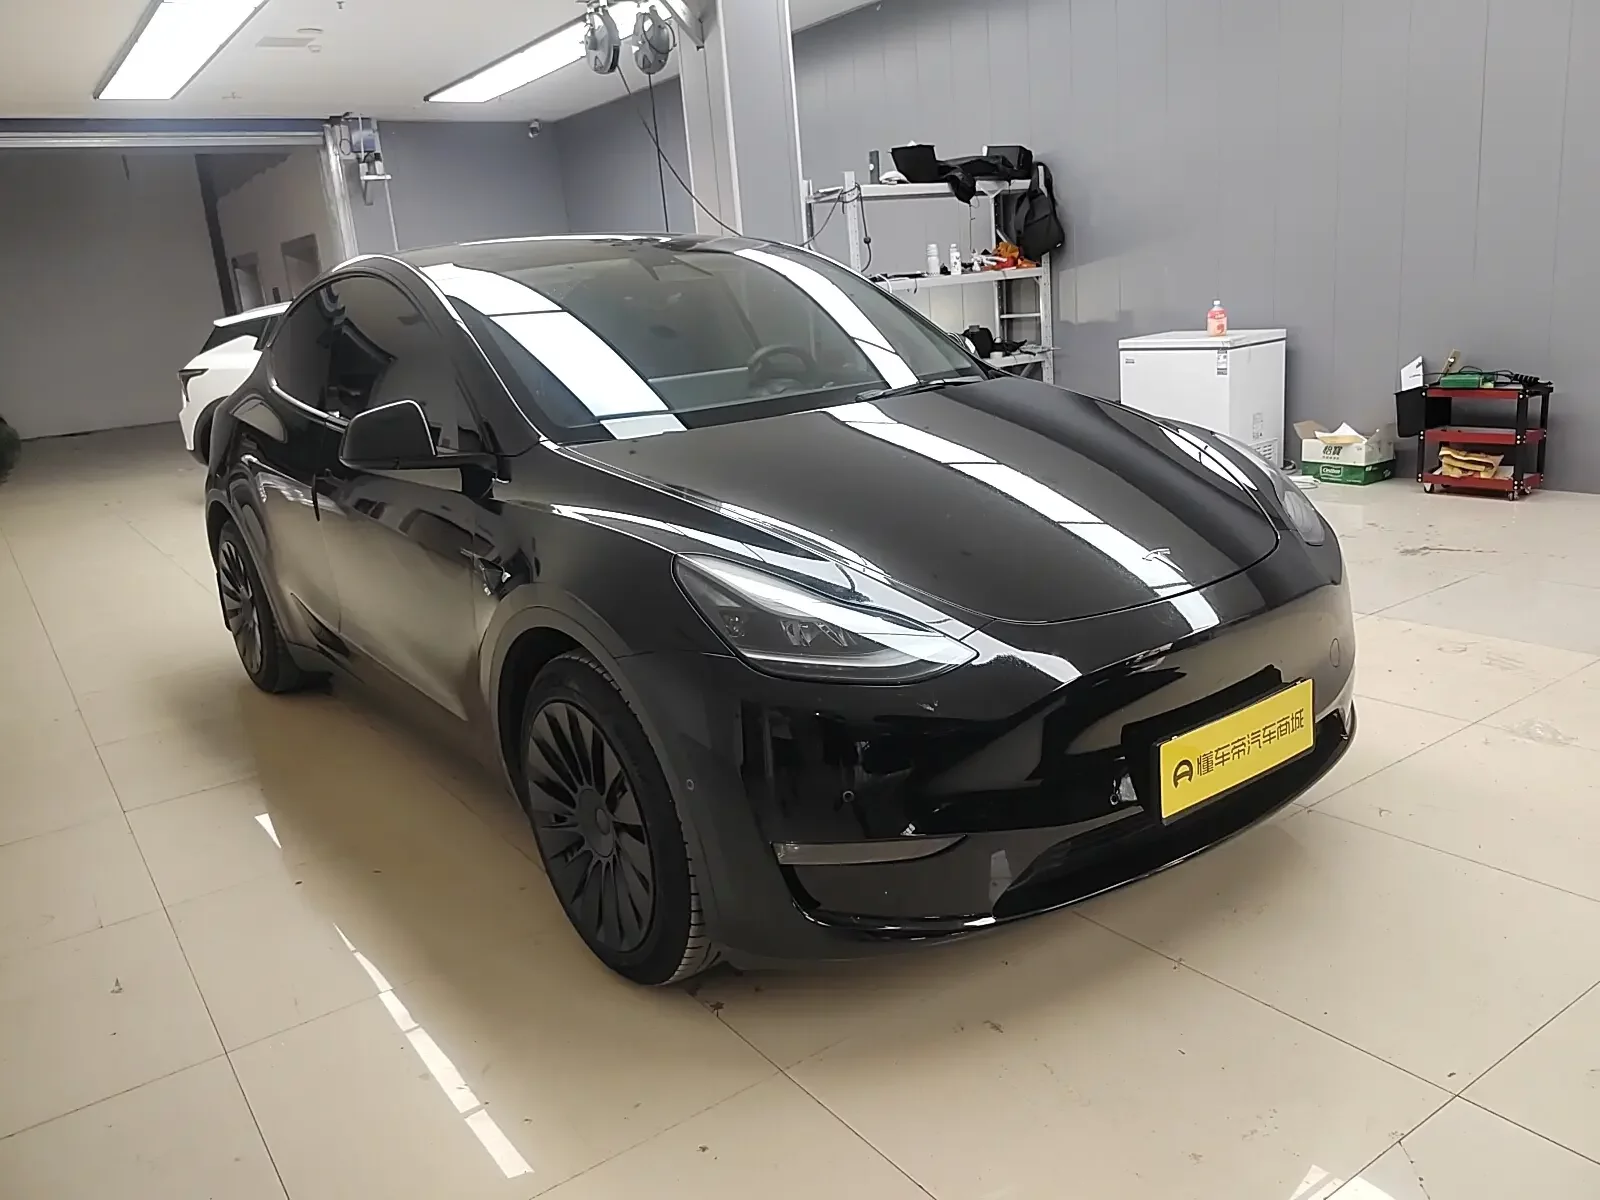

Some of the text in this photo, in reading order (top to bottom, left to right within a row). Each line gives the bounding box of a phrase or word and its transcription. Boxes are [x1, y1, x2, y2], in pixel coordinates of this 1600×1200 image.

[1196, 708, 1304, 776] 懂车帝汽车商城
